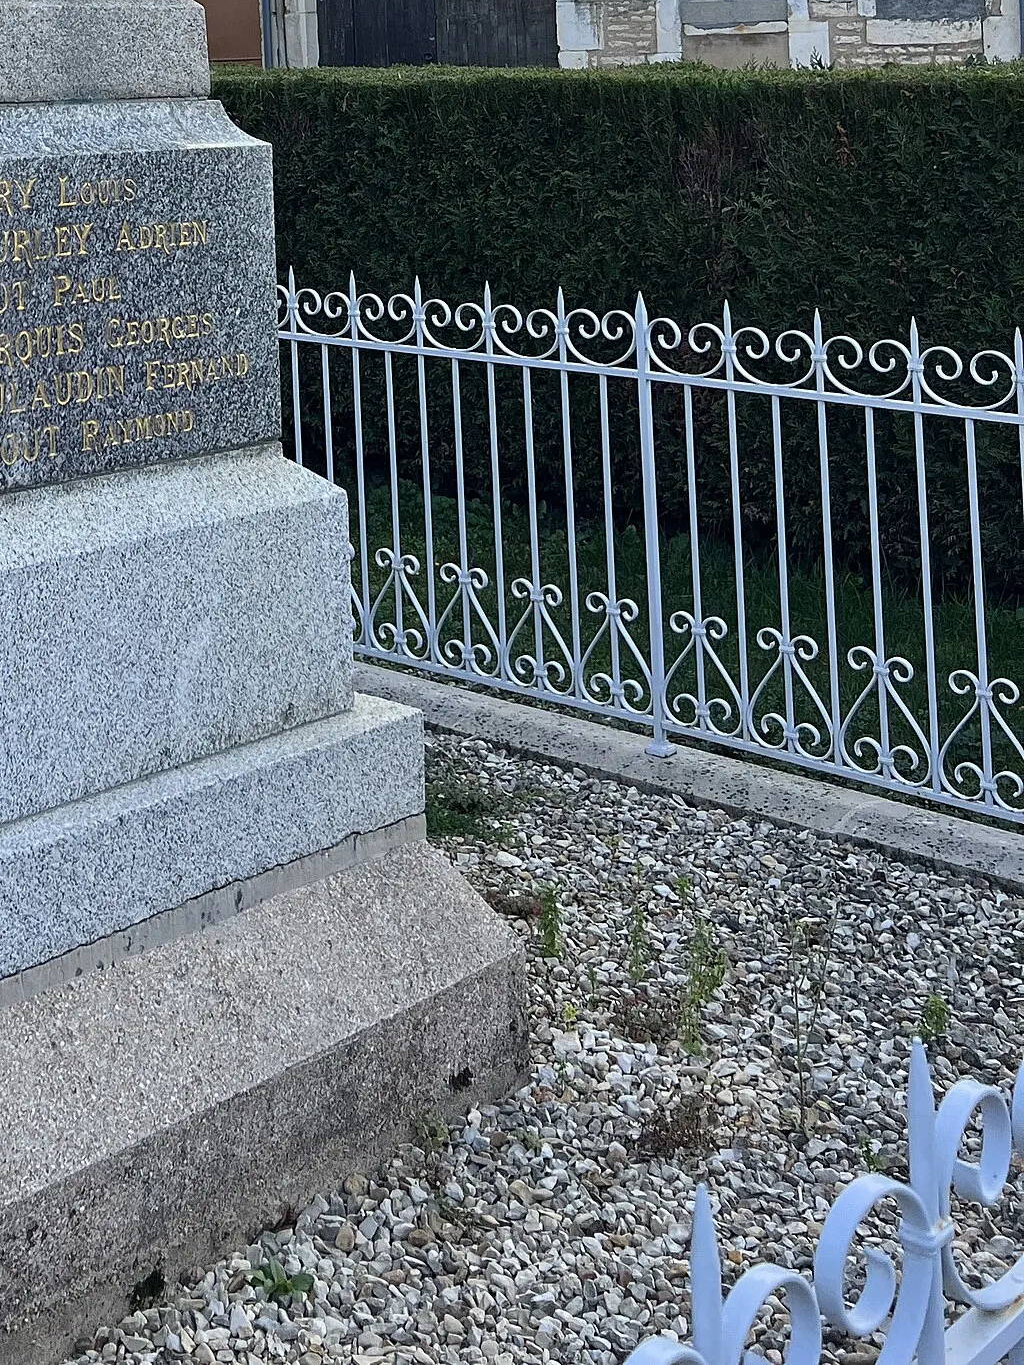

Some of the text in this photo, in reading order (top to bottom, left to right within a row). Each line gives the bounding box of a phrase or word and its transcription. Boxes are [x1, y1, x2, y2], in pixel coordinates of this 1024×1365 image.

[116, 220, 209, 255] ADRIEN
[53, 275, 122, 307] PAUL
[107, 312, 214, 349] GEORGES
[144, 353, 250, 391] FERNAND
[82, 410, 195, 453] RAYMOND
